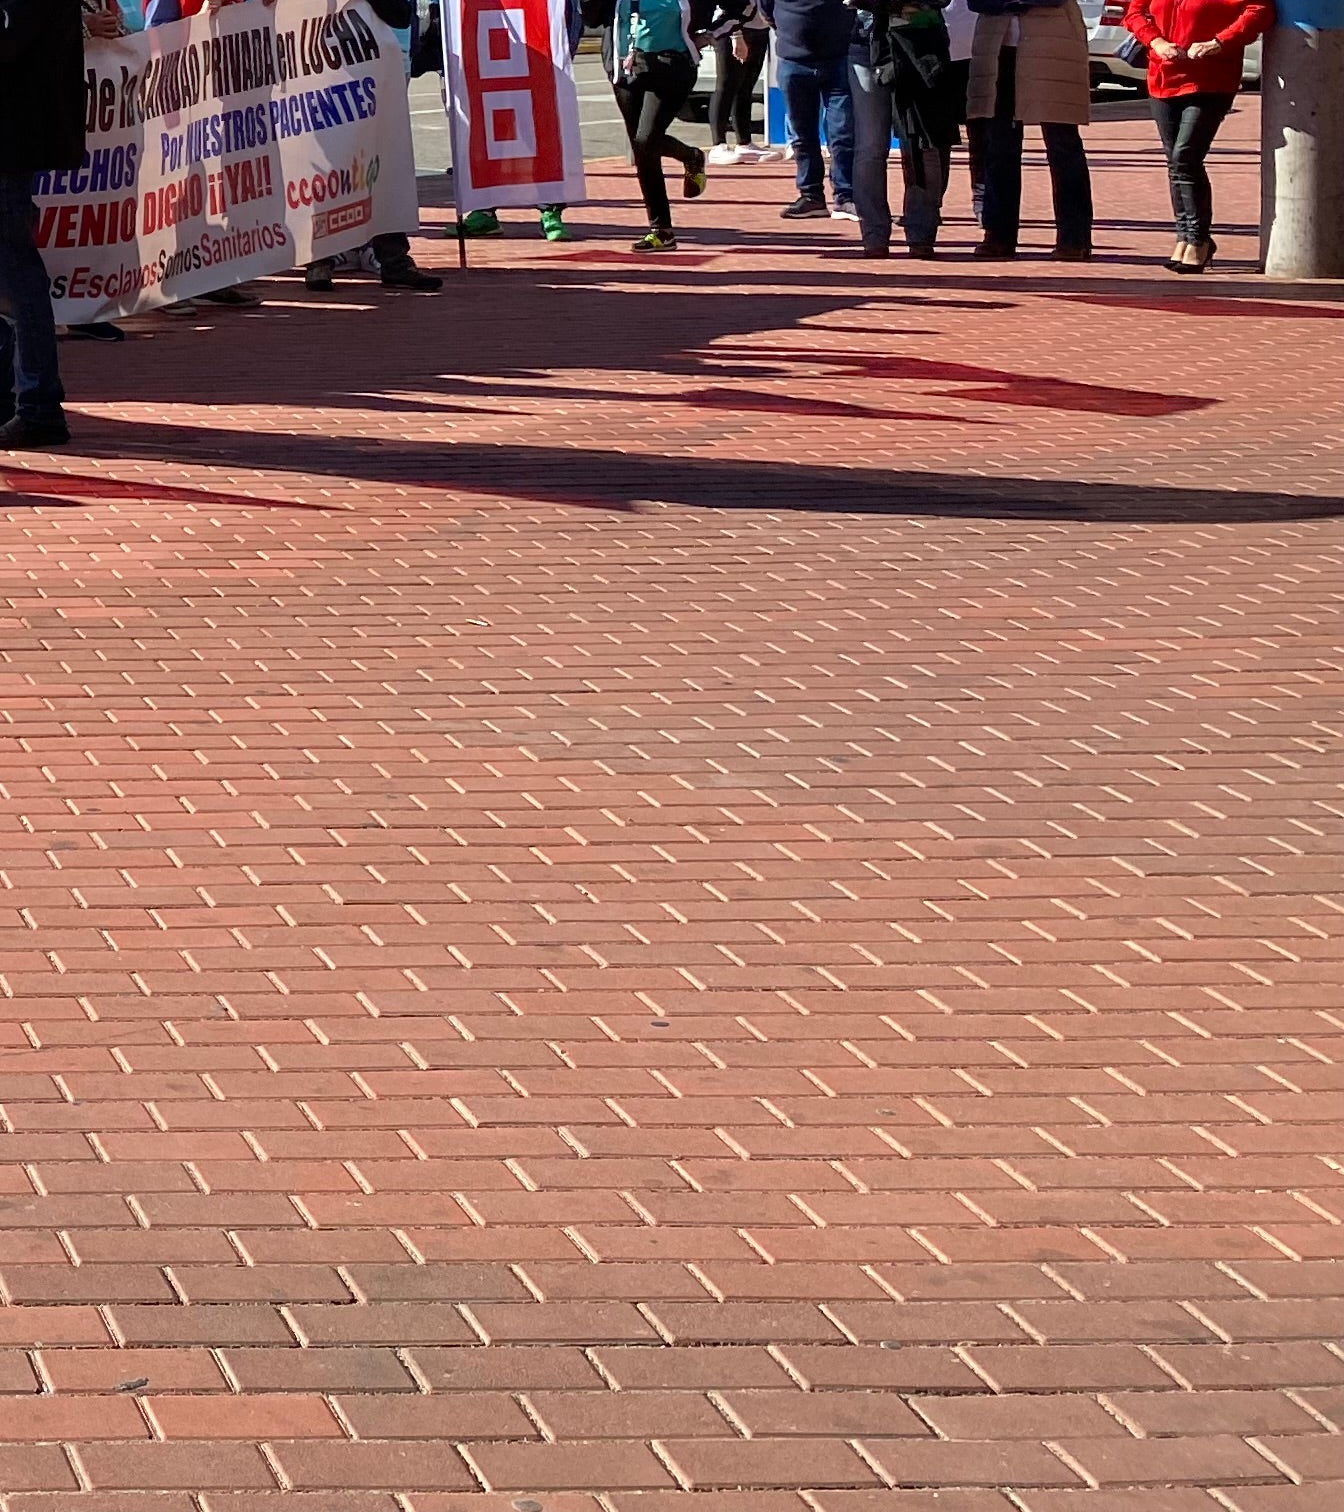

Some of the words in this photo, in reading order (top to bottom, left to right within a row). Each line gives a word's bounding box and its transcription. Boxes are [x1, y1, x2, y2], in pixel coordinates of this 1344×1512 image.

[201, 26, 276, 102] PRIVADA
[277, 29, 298, 84] en
[300, 8, 381, 76] LUCHA
[185, 104, 268, 167] NUESTROS
[269, 76, 378, 142] PACIENTES
[142, 173, 203, 237] DIGNO
